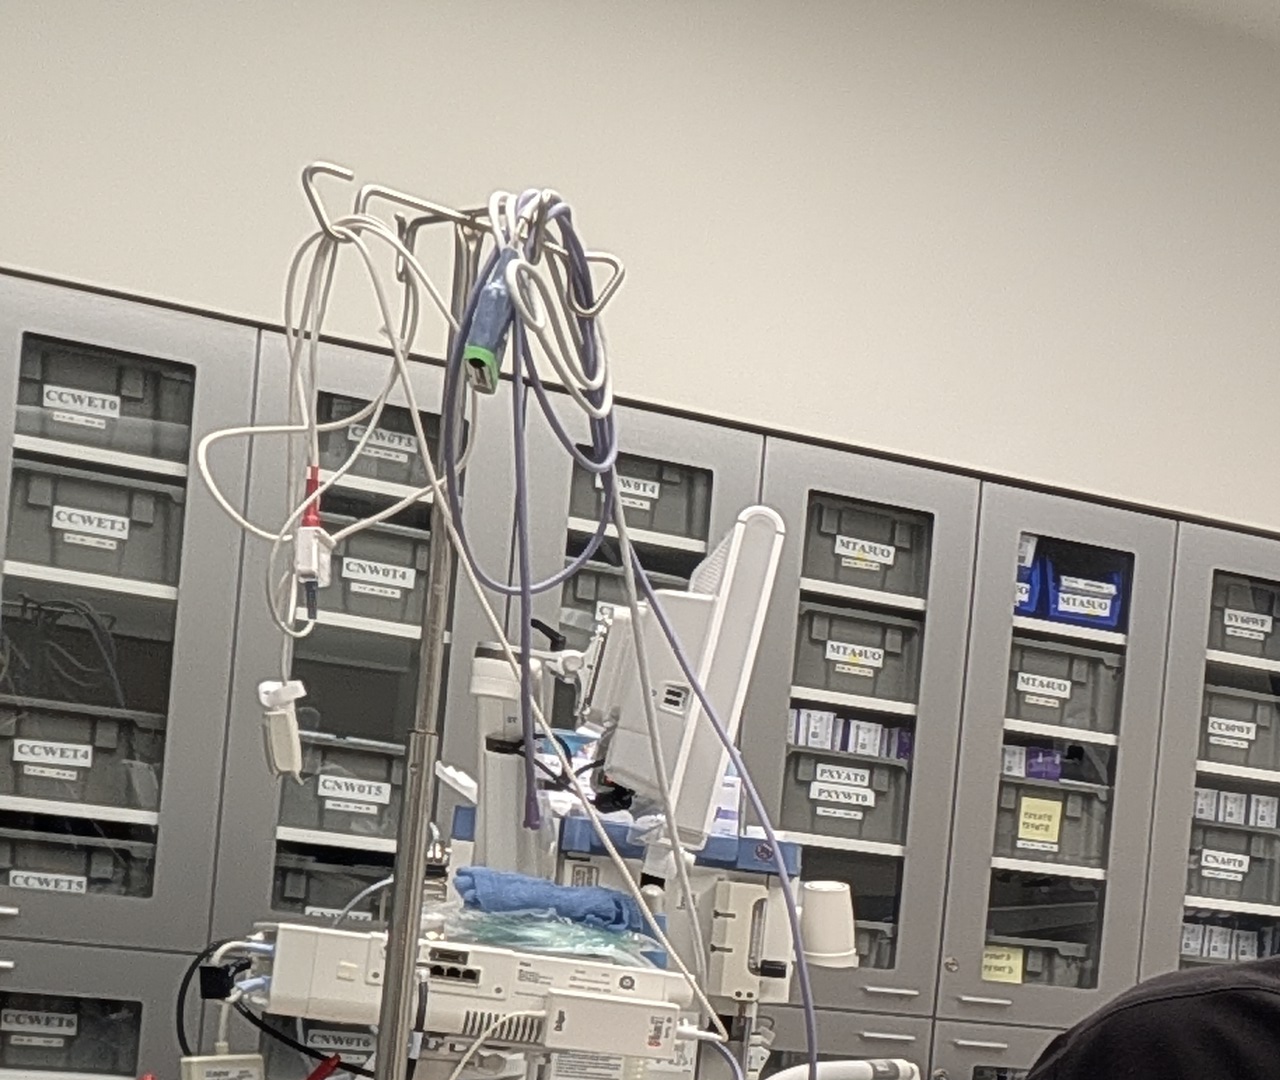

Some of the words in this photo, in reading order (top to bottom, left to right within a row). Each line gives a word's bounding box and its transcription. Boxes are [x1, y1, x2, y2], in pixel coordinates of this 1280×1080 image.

[54, 510, 128, 533] CCWET3
[17, 742, 91, 762] CCWET4
[320, 779, 384, 797] CNW0T5
[11, 873, 86, 892] CCWET5
